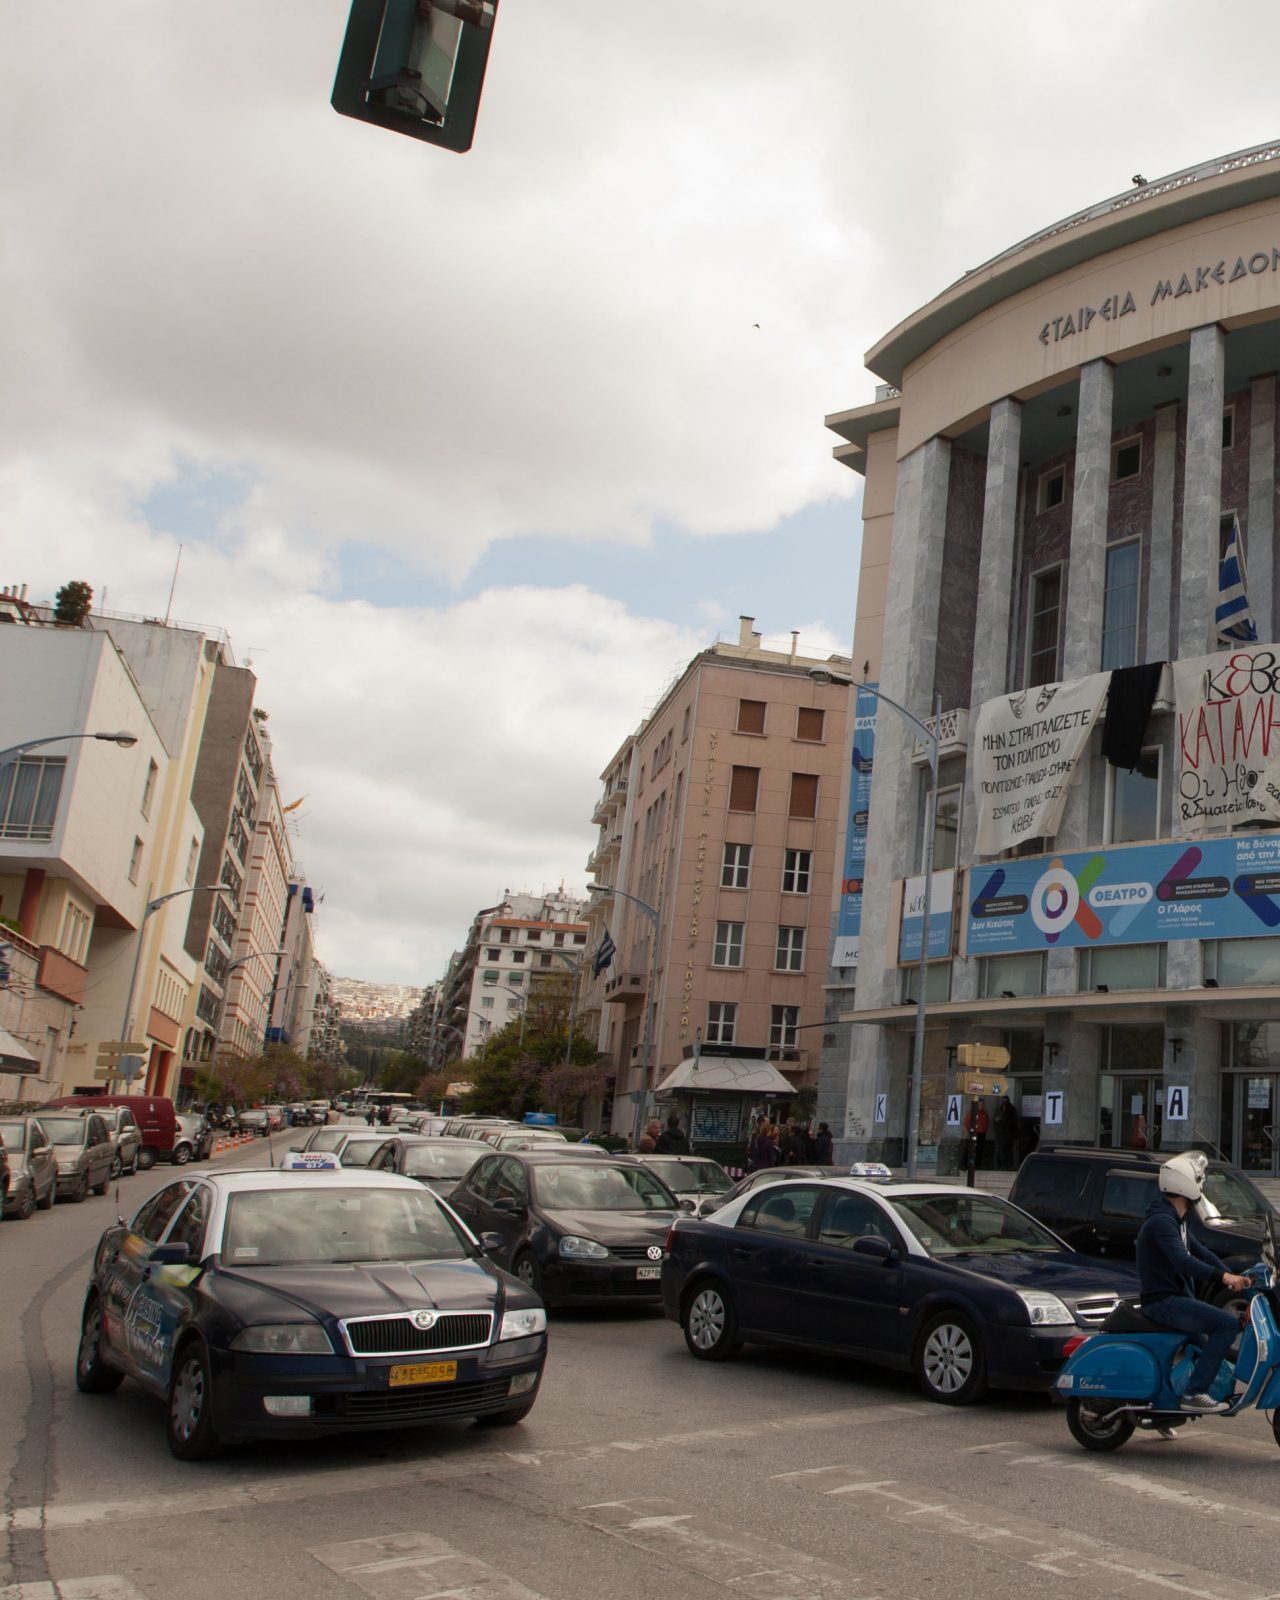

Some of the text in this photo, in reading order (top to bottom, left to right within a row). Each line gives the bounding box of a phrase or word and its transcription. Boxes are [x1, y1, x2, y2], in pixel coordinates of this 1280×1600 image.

[983, 731, 1006, 751] ΜΗΝ
[993, 752, 1015, 771] ΤΟΝ
[1236, 841, 1251, 850] Με
[1236, 851, 1255, 861] από
[1258, 851, 1274, 859] την
[1095, 887, 1147, 902] ΘΕΑΤΡΟ
[1167, 904, 1202, 914] Γλάρος
